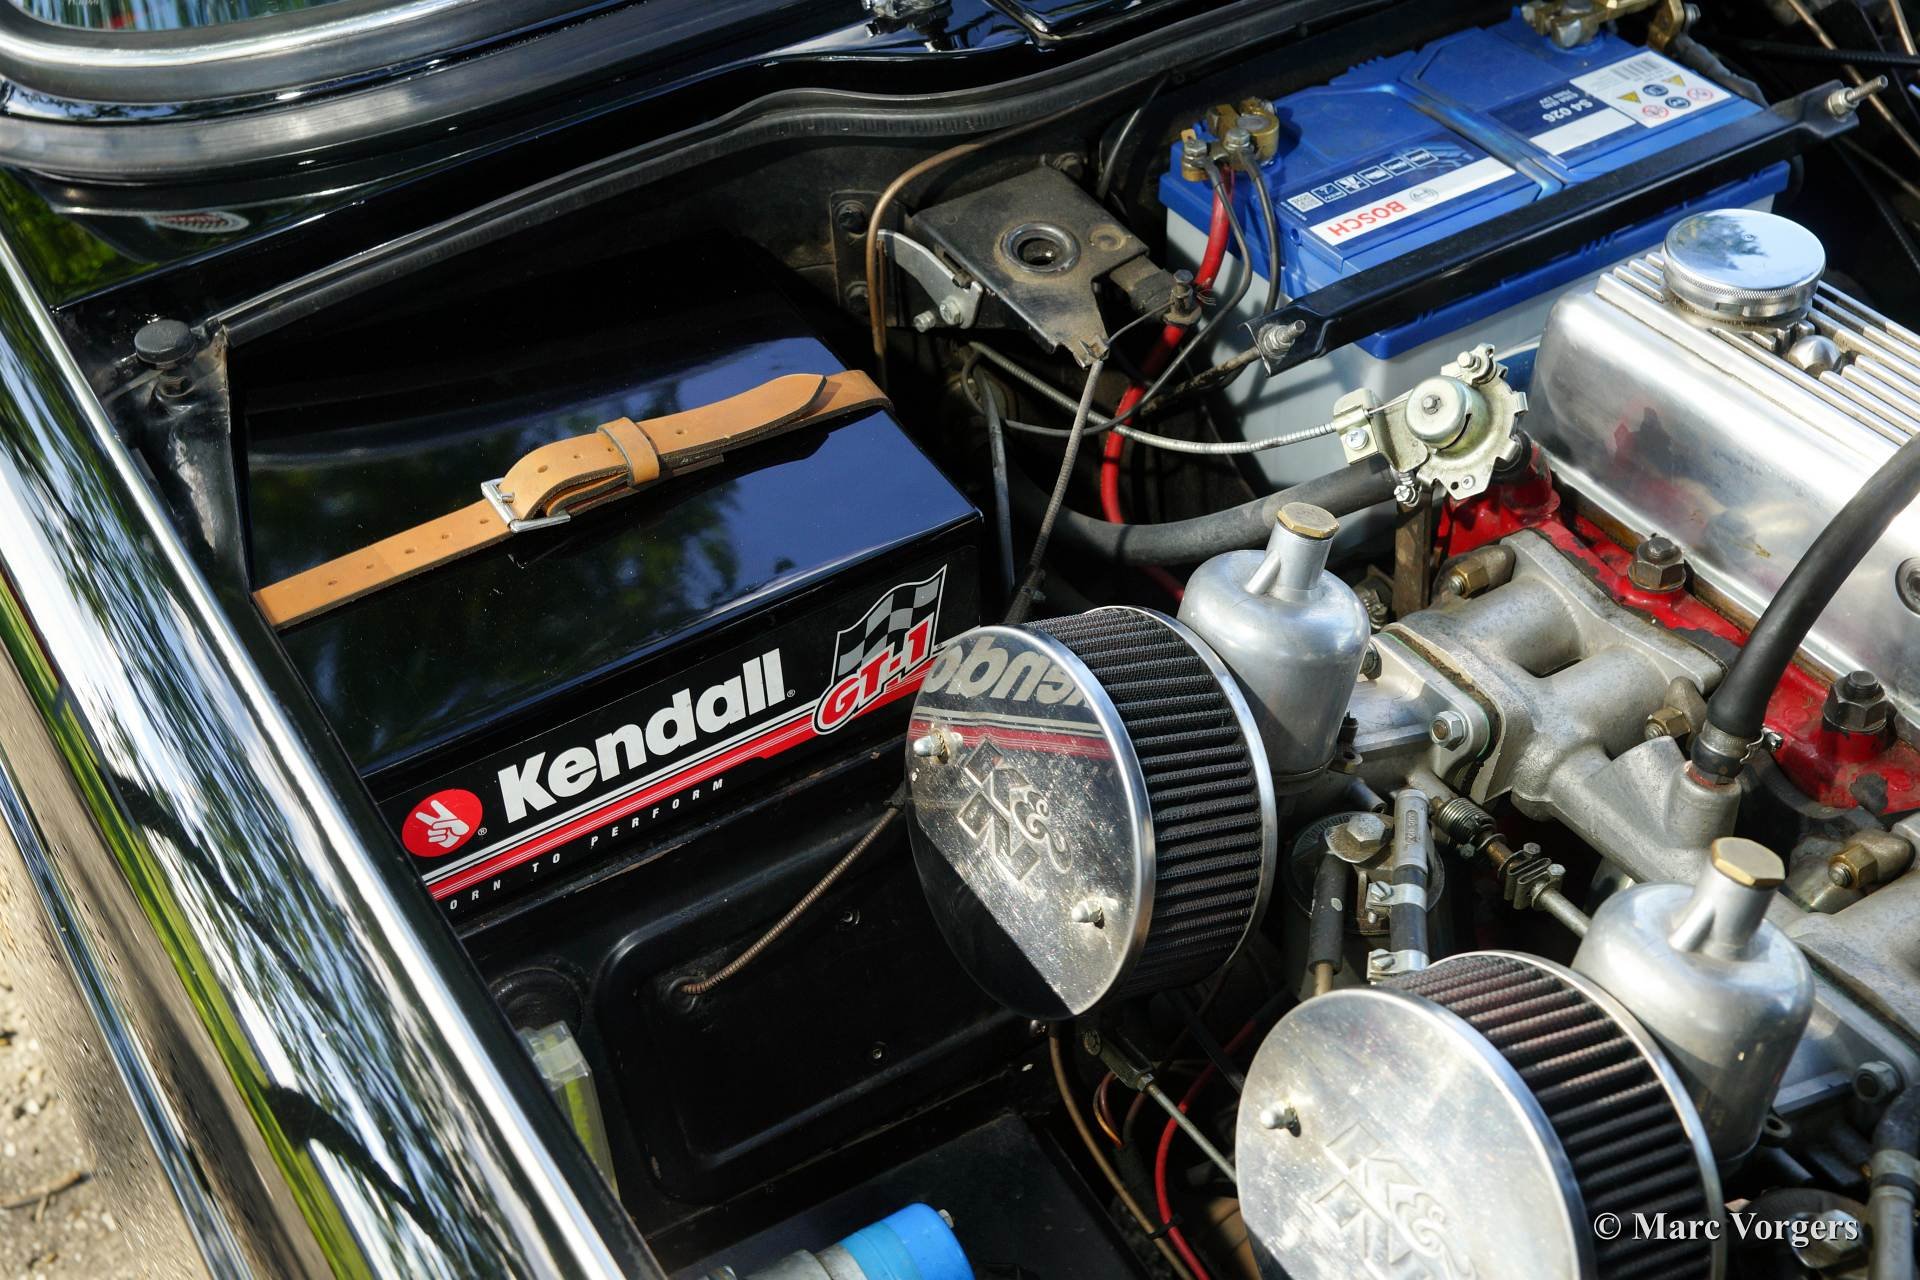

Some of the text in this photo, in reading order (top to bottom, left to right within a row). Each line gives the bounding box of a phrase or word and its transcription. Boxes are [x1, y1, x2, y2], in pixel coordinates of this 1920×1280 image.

[1542, 107, 1572, 122] 026
[1570, 99, 1593, 111] S4
[1327, 201, 1407, 236] BOSCH
[815, 614, 934, 734] GT-1
[498, 648, 785, 823] Kendall
[450, 778, 723, 911] ORN TO PERFORM
